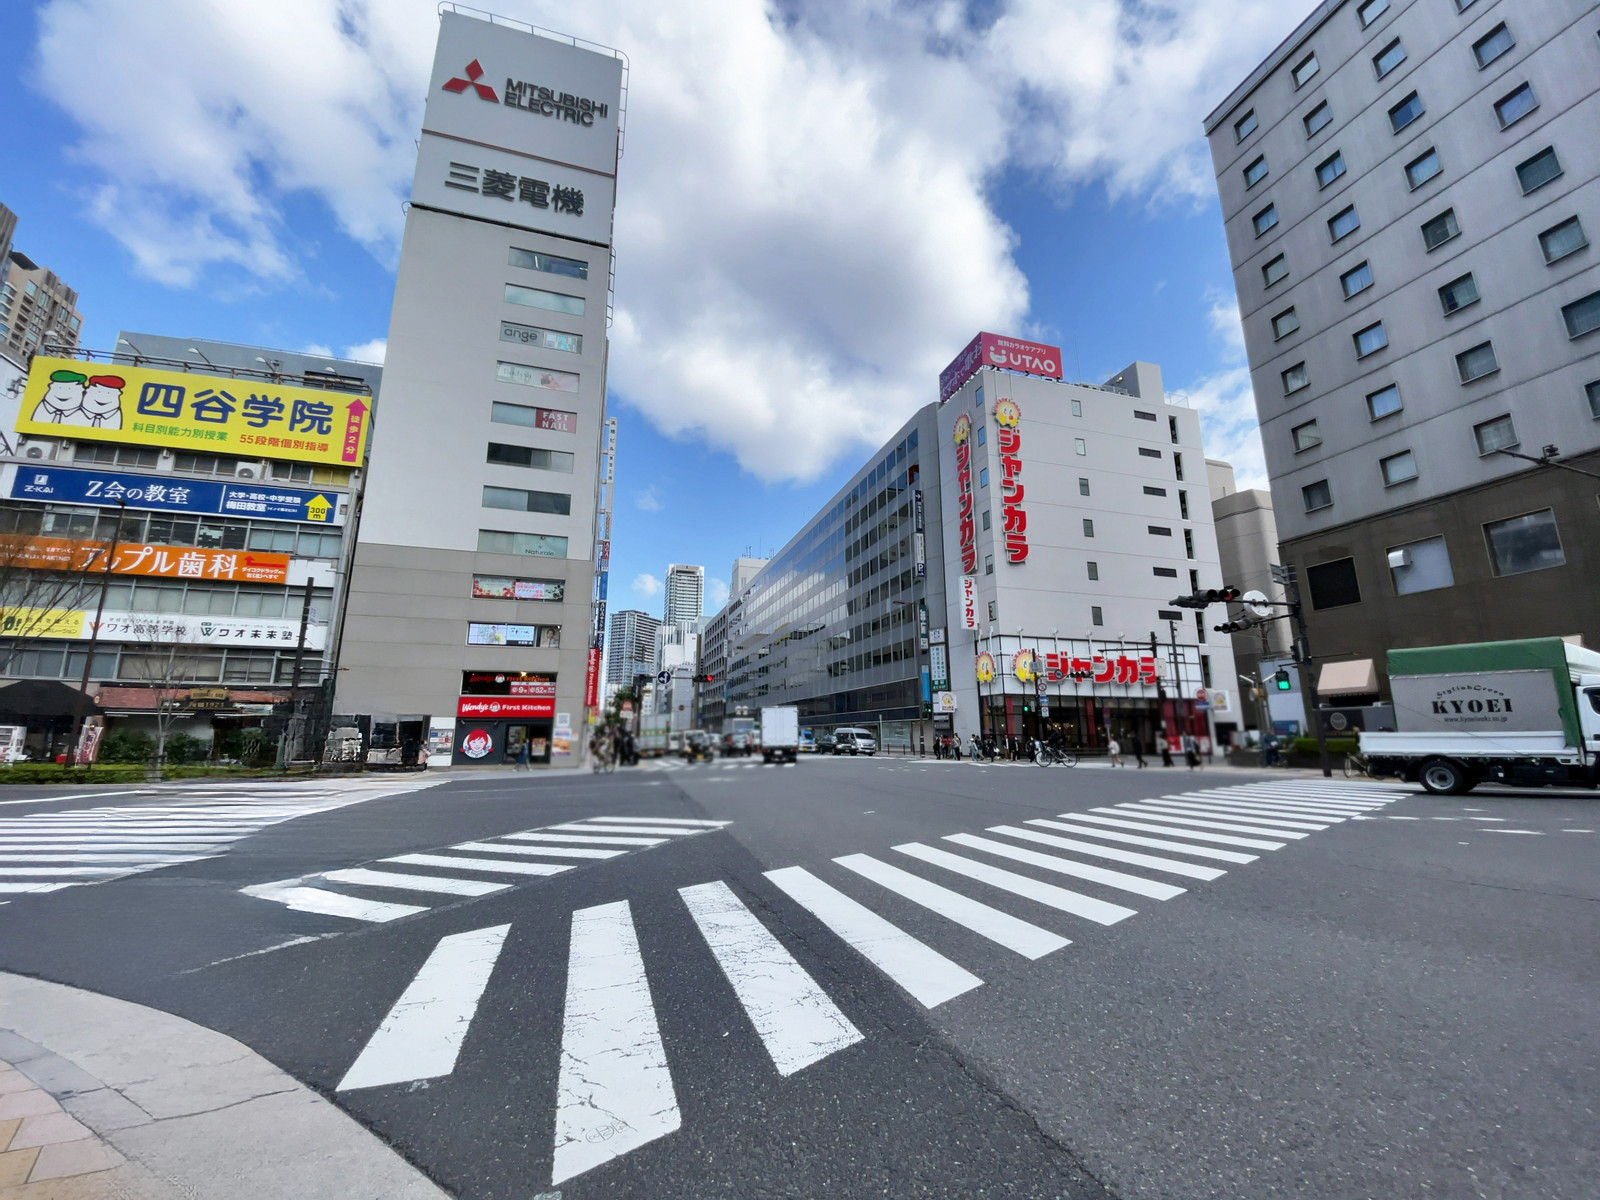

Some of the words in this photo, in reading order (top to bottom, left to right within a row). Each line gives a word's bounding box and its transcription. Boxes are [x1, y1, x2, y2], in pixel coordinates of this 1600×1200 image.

[504, 91, 594, 127] ELECTRIC
[506, 77, 608, 119] MITSUBISHI
[444, 161, 584, 217] 三菱電機
[504, 328, 538, 343] ange
[136, 382, 335, 435] 四谷学院
[543, 411, 569, 421] FAST
[132, 422, 228, 442] 科目別能力別授業
[542, 420, 568, 431] NAIL
[239, 433, 329, 453] 55段階個別指導
[85, 480, 191, 505] Z会の教室
[999, 428, 1029, 563] ジャンカラ
[310, 507, 326, 515] 300
[956, 444, 977, 575] ジャンカラ
[78, 546, 239, 579] アップル歯科
[964, 579, 975, 628] ジャンカラ
[107, 623, 187, 636] ワオ高等学校
[462, 702, 488, 713] Wendy's
[1432, 698, 1513, 714] KYOEI
